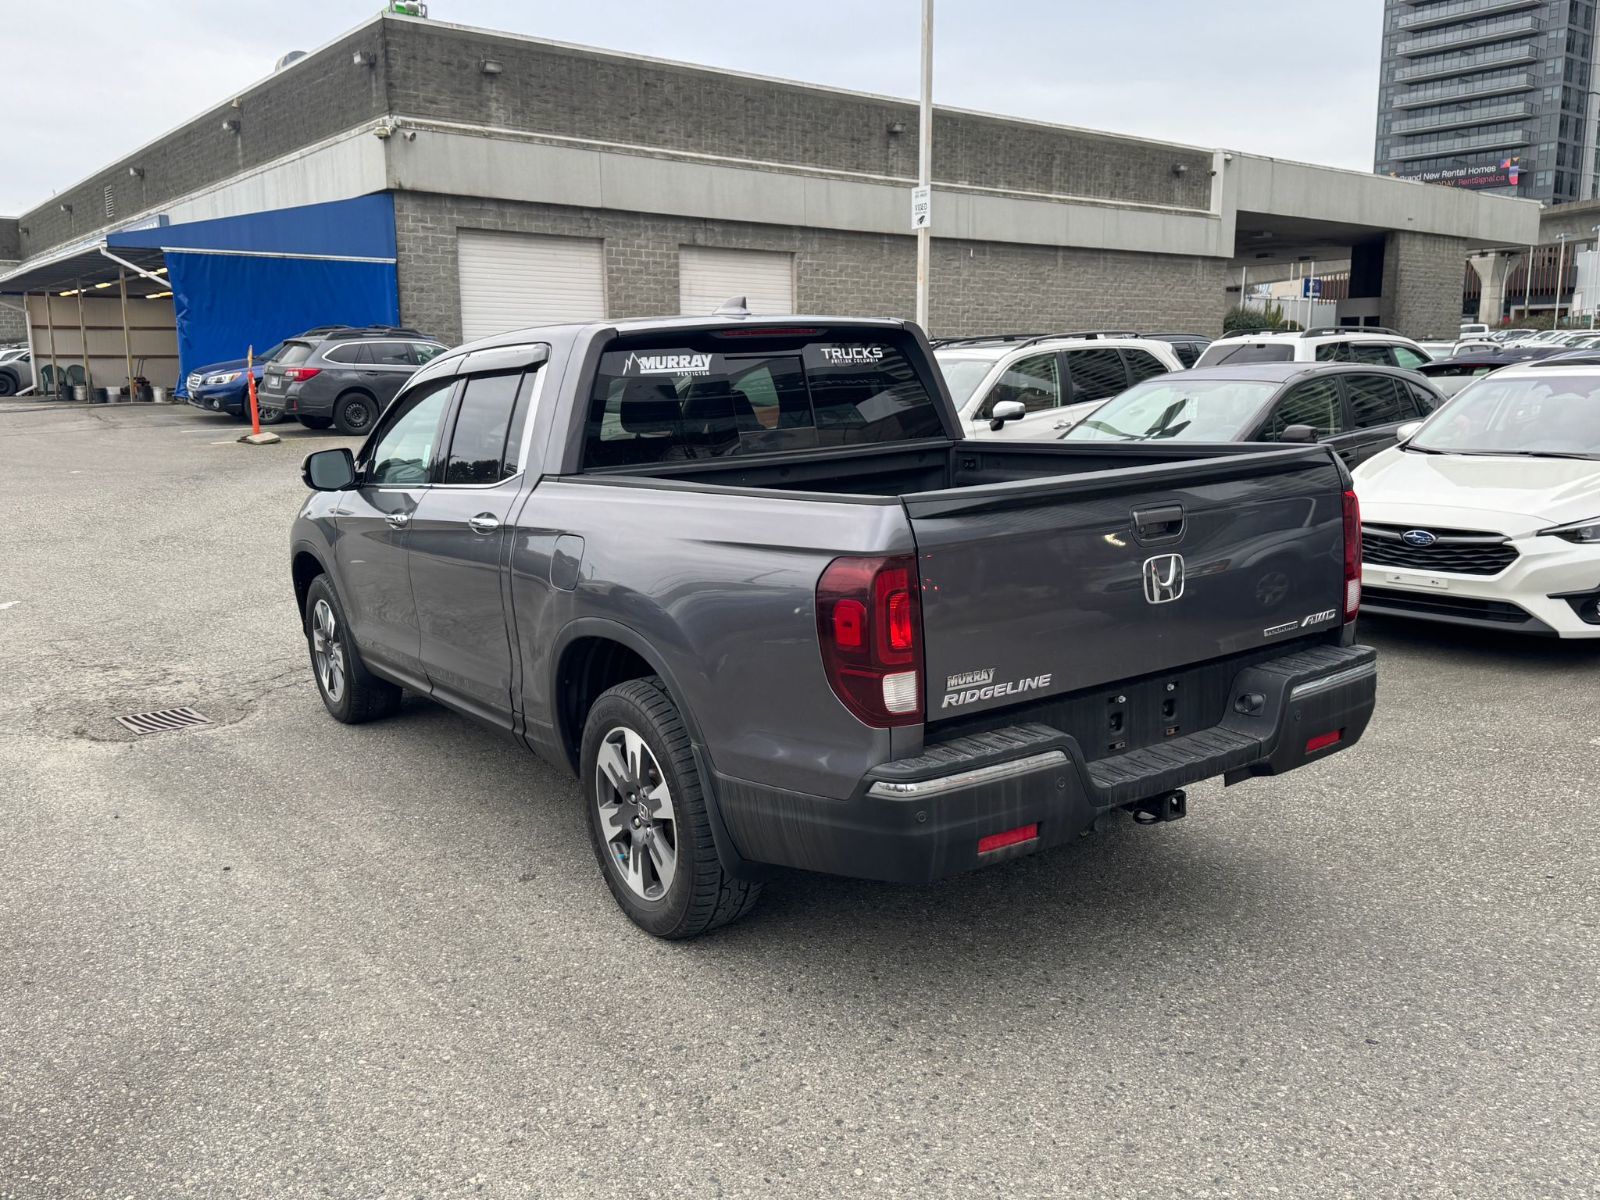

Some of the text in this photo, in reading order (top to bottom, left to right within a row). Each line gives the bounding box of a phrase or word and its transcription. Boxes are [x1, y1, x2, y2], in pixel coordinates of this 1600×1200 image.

[1423, 172, 1440, 181] New
[1441, 168, 1466, 179] Rental
[1468, 165, 1497, 176] Homes
[820, 347, 883, 360] TRUCKS
[640, 354, 712, 371] MURRAY
[1301, 609, 1337, 627] AWD
[946, 668, 996, 689] MURRAY
[941, 674, 1052, 708] RIDGELINE
